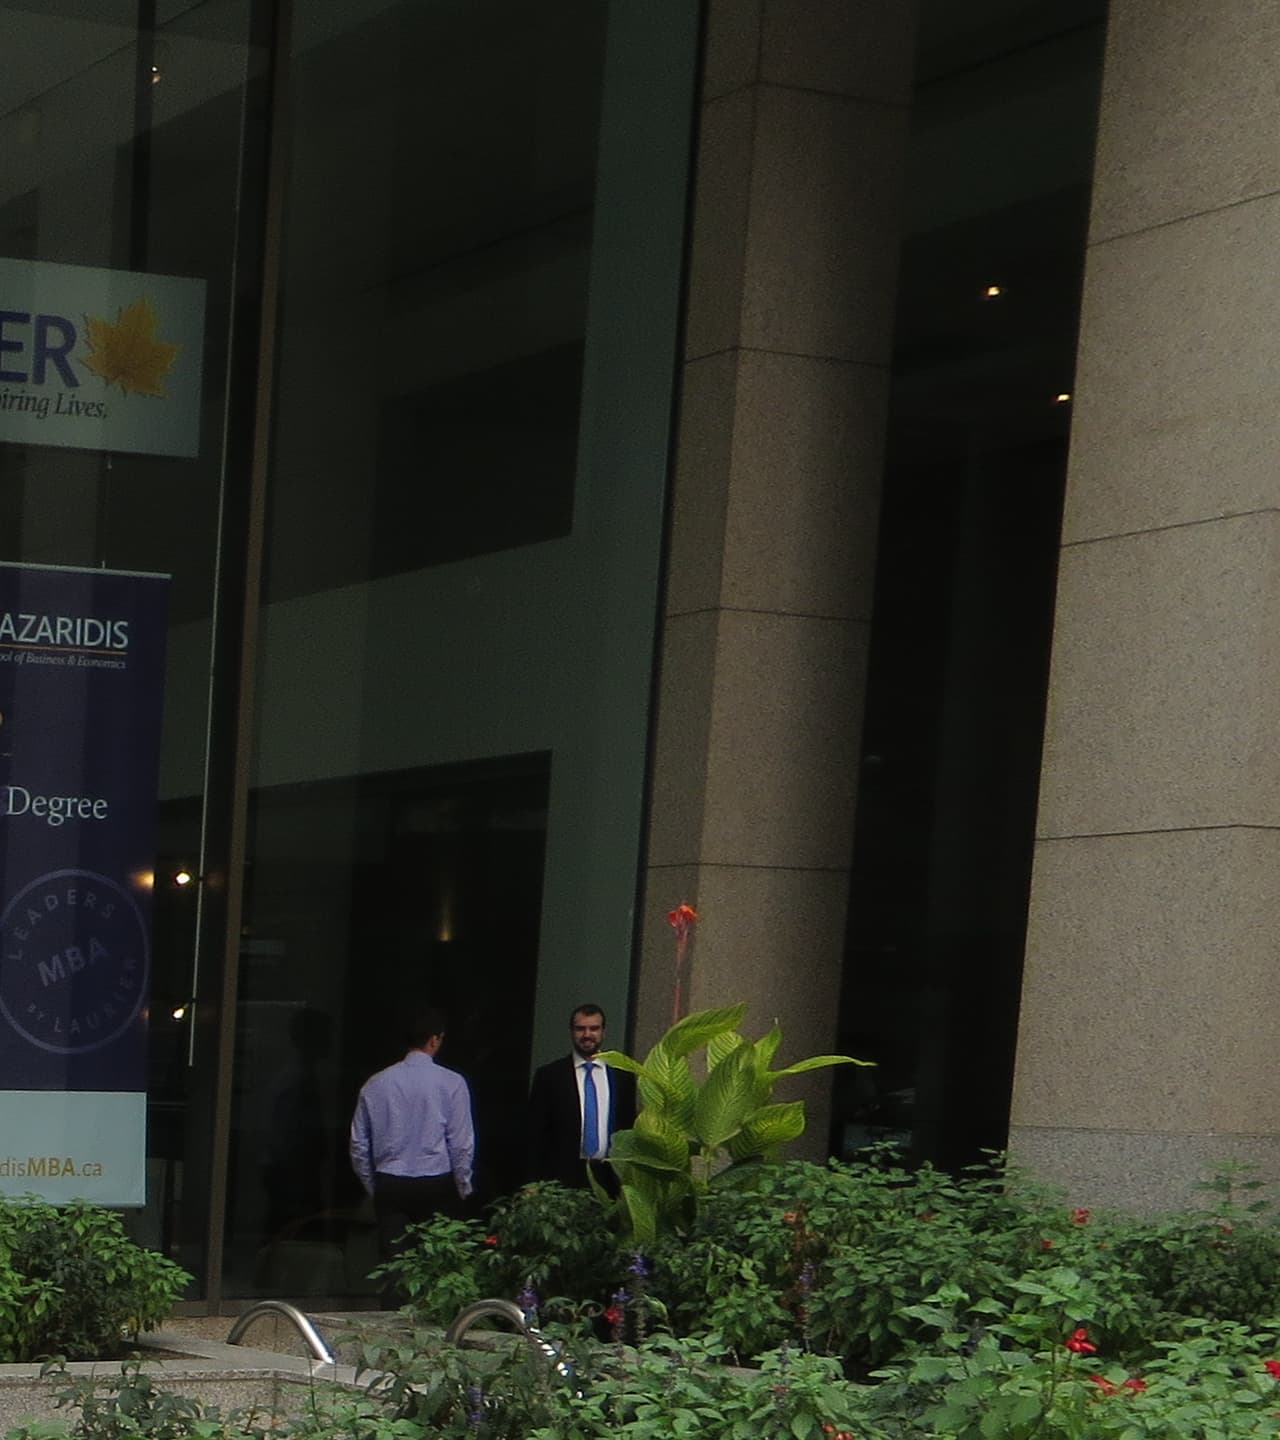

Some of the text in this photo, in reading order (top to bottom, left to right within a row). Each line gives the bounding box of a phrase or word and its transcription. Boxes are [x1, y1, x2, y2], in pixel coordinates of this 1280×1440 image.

[14, 651, 26, 666] of
[26, 651, 65, 666] Business
[77, 656, 126, 670] Economics
[6, 785, 109, 827] Degree
[7, 888, 115, 960] LEADERS
[37, 936, 112, 987] MBA
